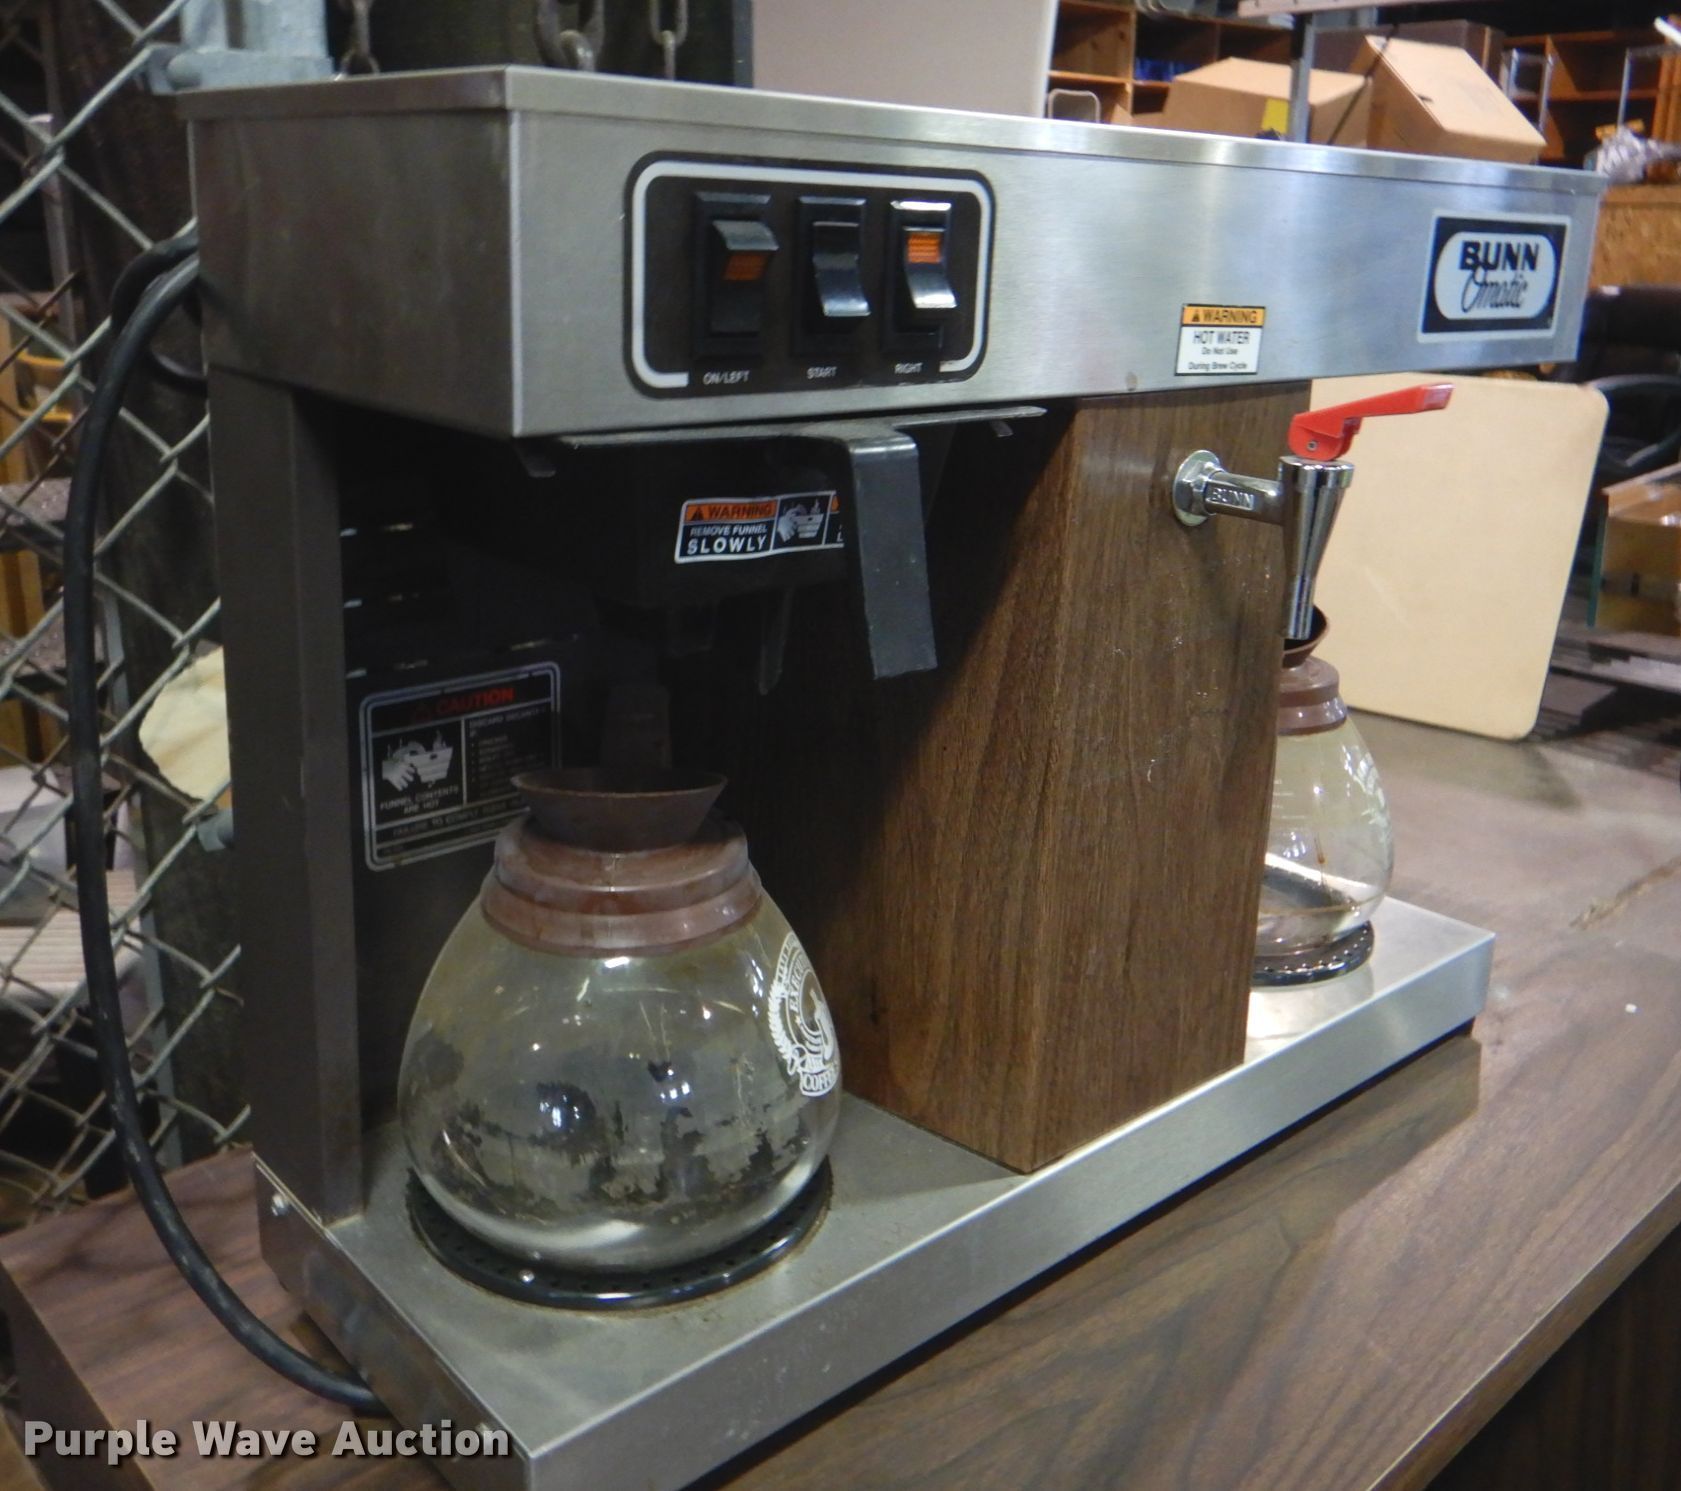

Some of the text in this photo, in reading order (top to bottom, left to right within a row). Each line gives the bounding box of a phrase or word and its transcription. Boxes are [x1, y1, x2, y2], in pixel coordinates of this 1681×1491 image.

[1459, 240, 1540, 271] BUNN
[1203, 309, 1257, 323] WARNING
[1193, 330, 1250, 344] HOT WATER
[1201, 347, 1238, 355] Do Not Use
[807, 366, 838, 379] START
[894, 362, 924, 375] RIGHT
[1188, 361, 1247, 371] During Brew Cycle
[703, 370, 750, 385] ON/LEFT
[1211, 487, 1254, 508] BUNN
[709, 502, 772, 519] WARNING
[689, 523, 768, 537] REMOVE FUNNEL
[686, 535, 768, 555] SLOWLY
[436, 687, 516, 715] CAUTION
[803, 1071, 836, 1091] COFF
